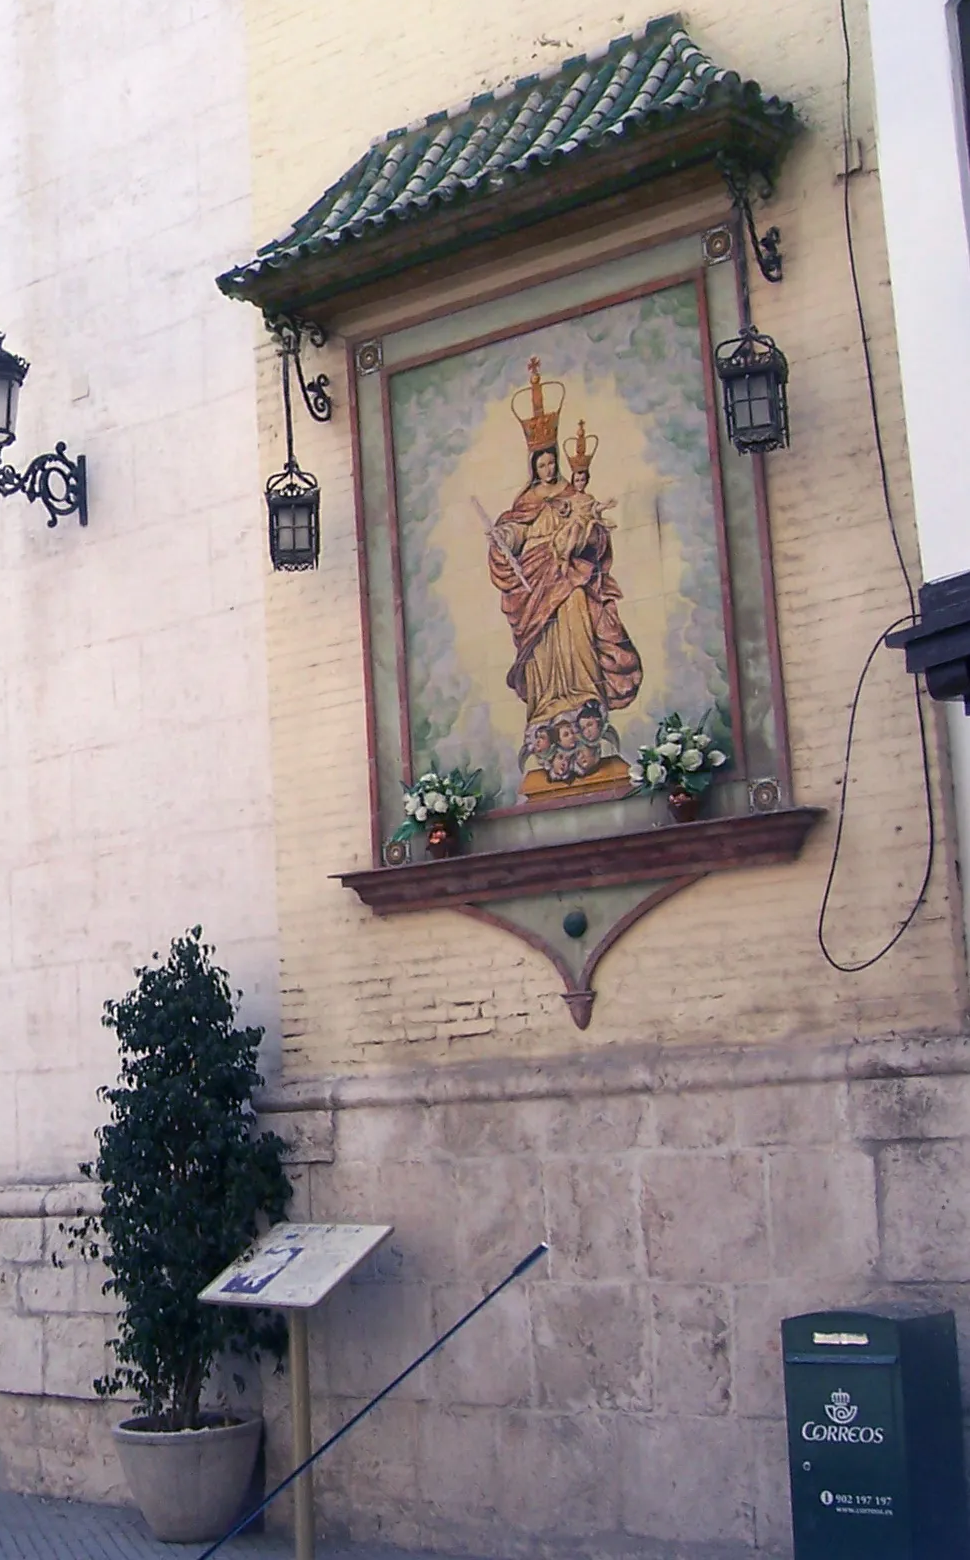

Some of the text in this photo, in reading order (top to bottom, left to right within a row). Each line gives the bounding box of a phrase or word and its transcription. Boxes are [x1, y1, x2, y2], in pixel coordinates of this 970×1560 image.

[802, 1421, 884, 1444] CORREOS
[835, 1493, 892, 1506] 902 197 197
